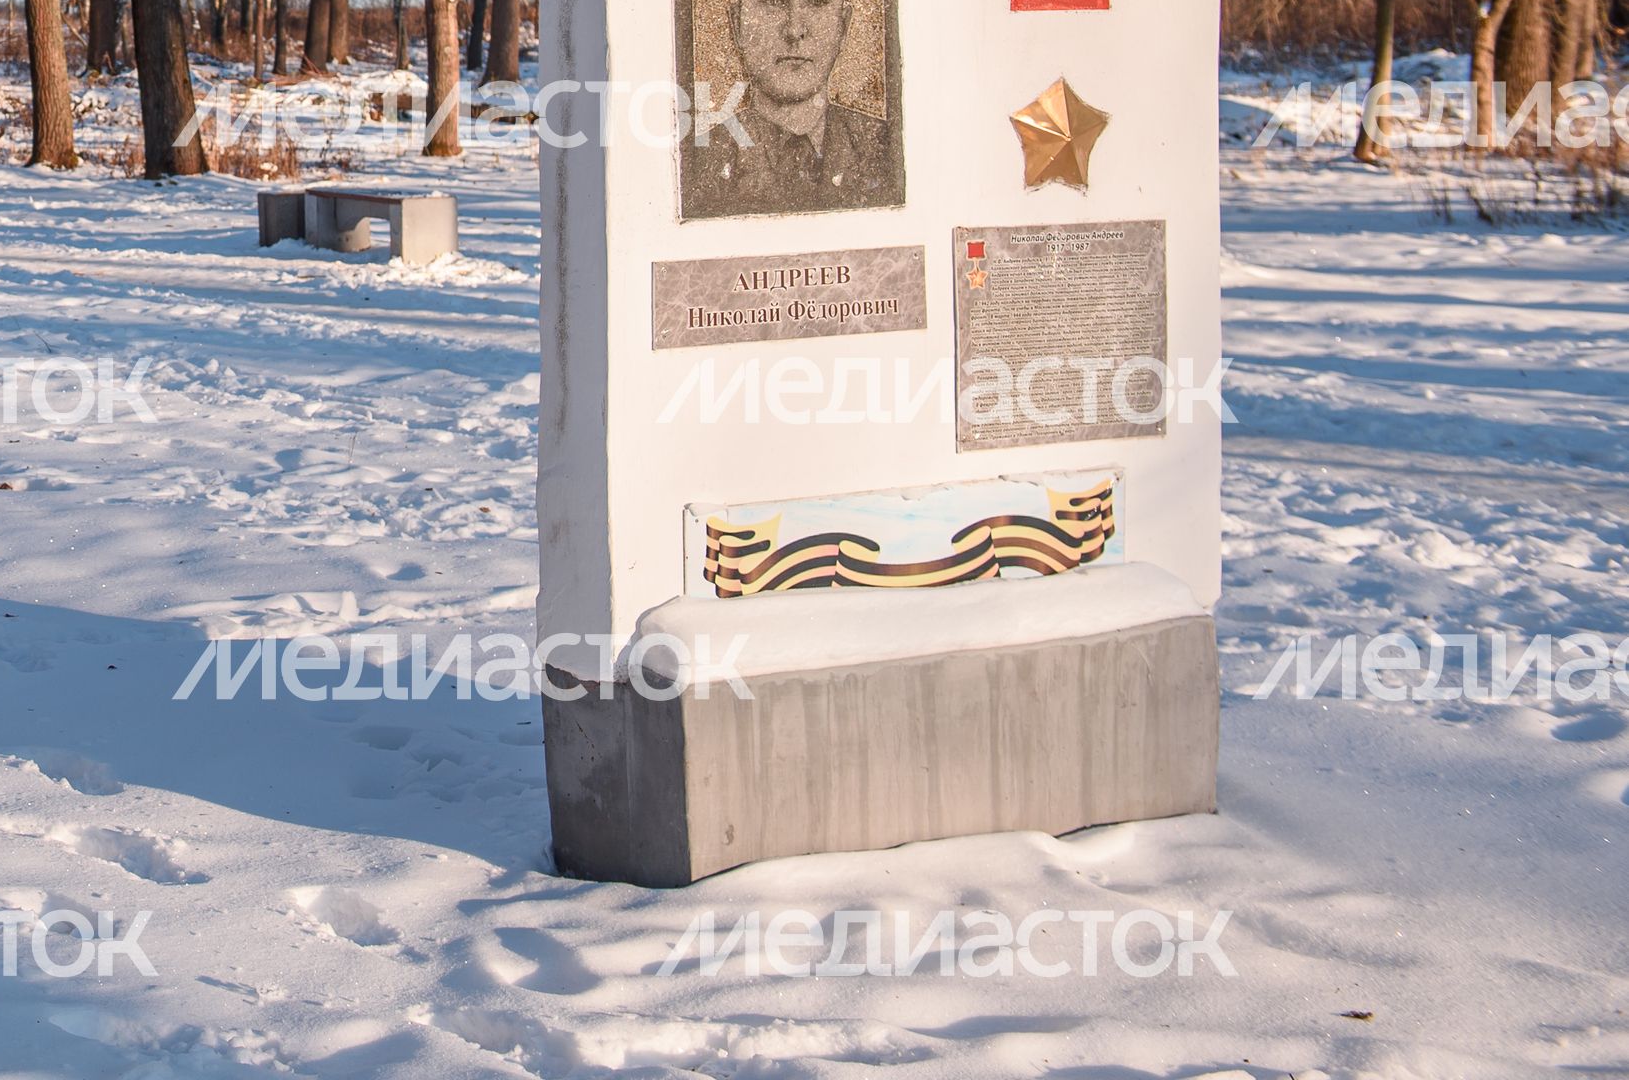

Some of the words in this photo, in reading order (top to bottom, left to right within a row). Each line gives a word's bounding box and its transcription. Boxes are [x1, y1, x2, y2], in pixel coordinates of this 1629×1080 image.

[1047, 243, 1065, 252] 1917
[1072, 242, 1090, 251] 1987
[734, 266, 851, 291] АНДРЕЕВ
[687, 302, 781, 329] Николай
[787, 299, 899, 324] Фёдорович
